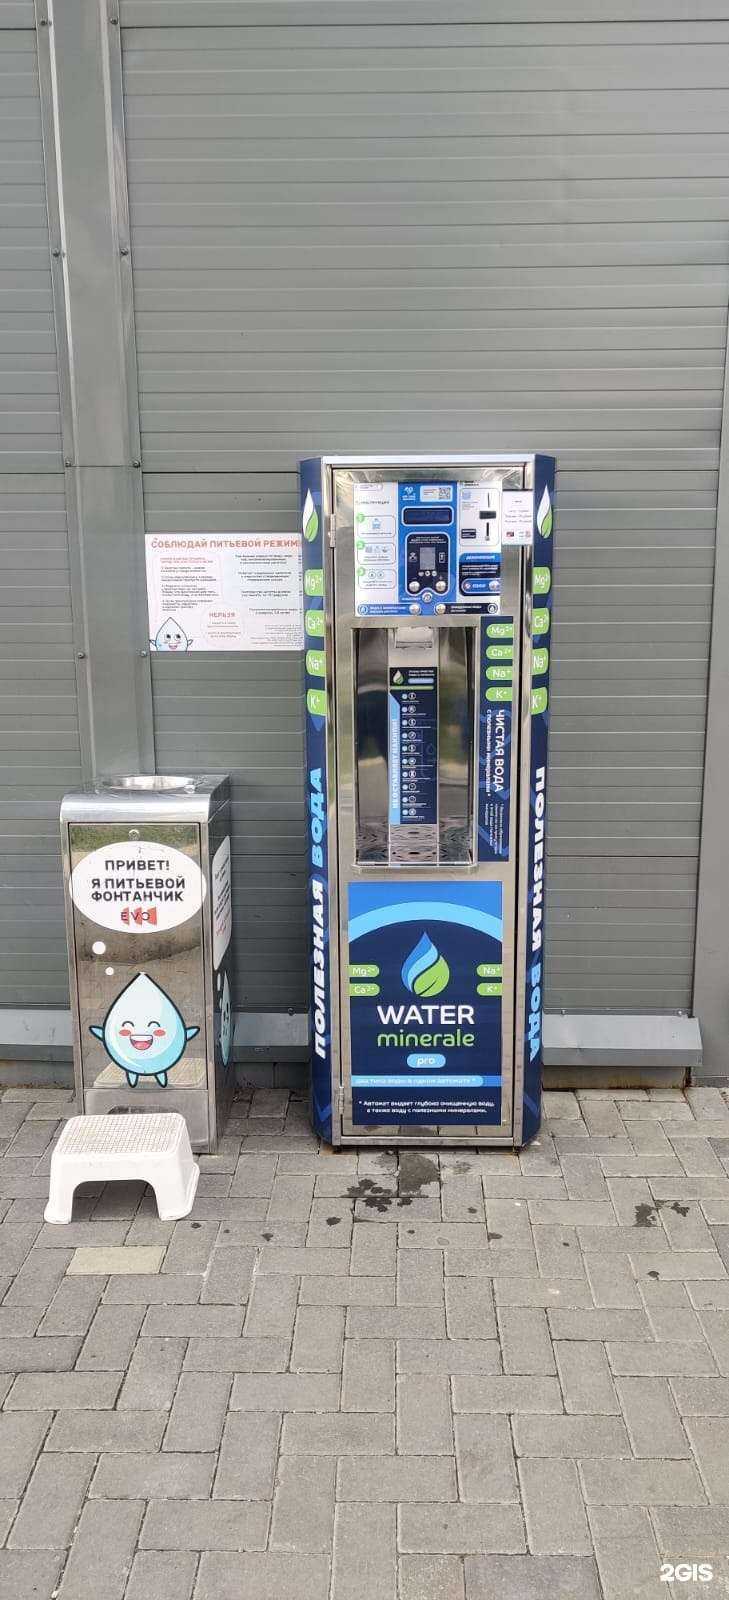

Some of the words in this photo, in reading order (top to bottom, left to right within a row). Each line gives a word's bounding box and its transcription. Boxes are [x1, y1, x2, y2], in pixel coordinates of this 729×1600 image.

[151, 538, 208, 550] СОБЛЮДАЙ
[209, 538, 262, 549] ПИТЬЕВОЙ
[495, 709, 505, 756] ЧИСТАЯ
[494, 758, 505, 793] ВОДА
[310, 768, 324, 868] ВОДА
[105, 860, 170, 871] ПРИВЕТ!
[532, 766, 546, 952] ПОЛЕЗНАЯ
[92, 878, 101, 889] Я
[105, 875, 186, 889] ПИТЬЕВОЙ
[91, 891, 185, 902] ФОНТАНЧИК
[120, 911, 150, 921] EVO
[312, 879, 326, 1060] ПОЛЕЗНАЯ
[376, 1005, 475, 1025] WATER
[528, 962, 542, 1063] ВОДА
[377, 1029, 475, 1047] minerale
[416, 1057, 436, 1067] pro
